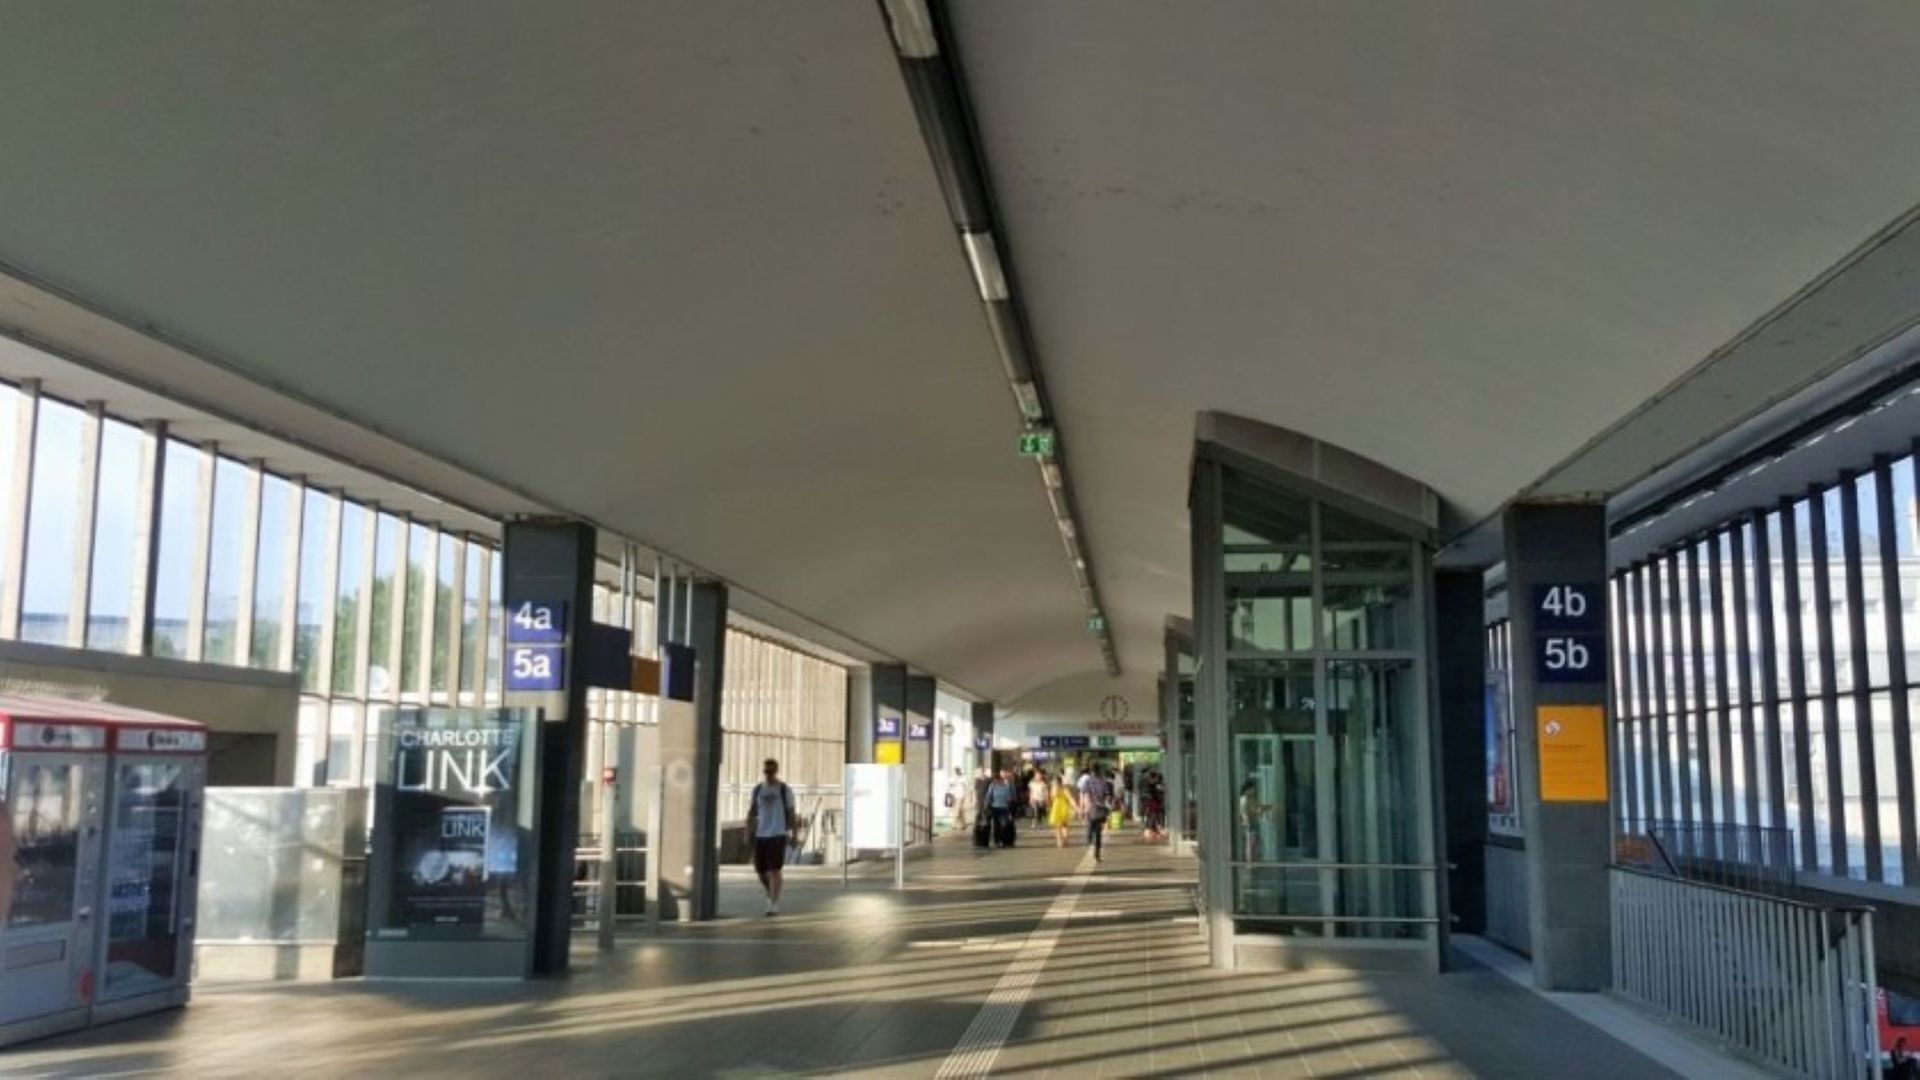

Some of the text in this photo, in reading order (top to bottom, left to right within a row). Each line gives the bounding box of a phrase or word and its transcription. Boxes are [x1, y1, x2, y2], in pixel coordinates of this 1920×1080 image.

[514, 601, 552, 630] 4a
[1541, 585, 1587, 616] 4b
[512, 648, 552, 678] 5a
[1545, 637, 1589, 669] 5b
[400, 728, 515, 746] CHARLOTTE
[398, 748, 511, 793] LINK
[441, 820, 485, 837] LINK
